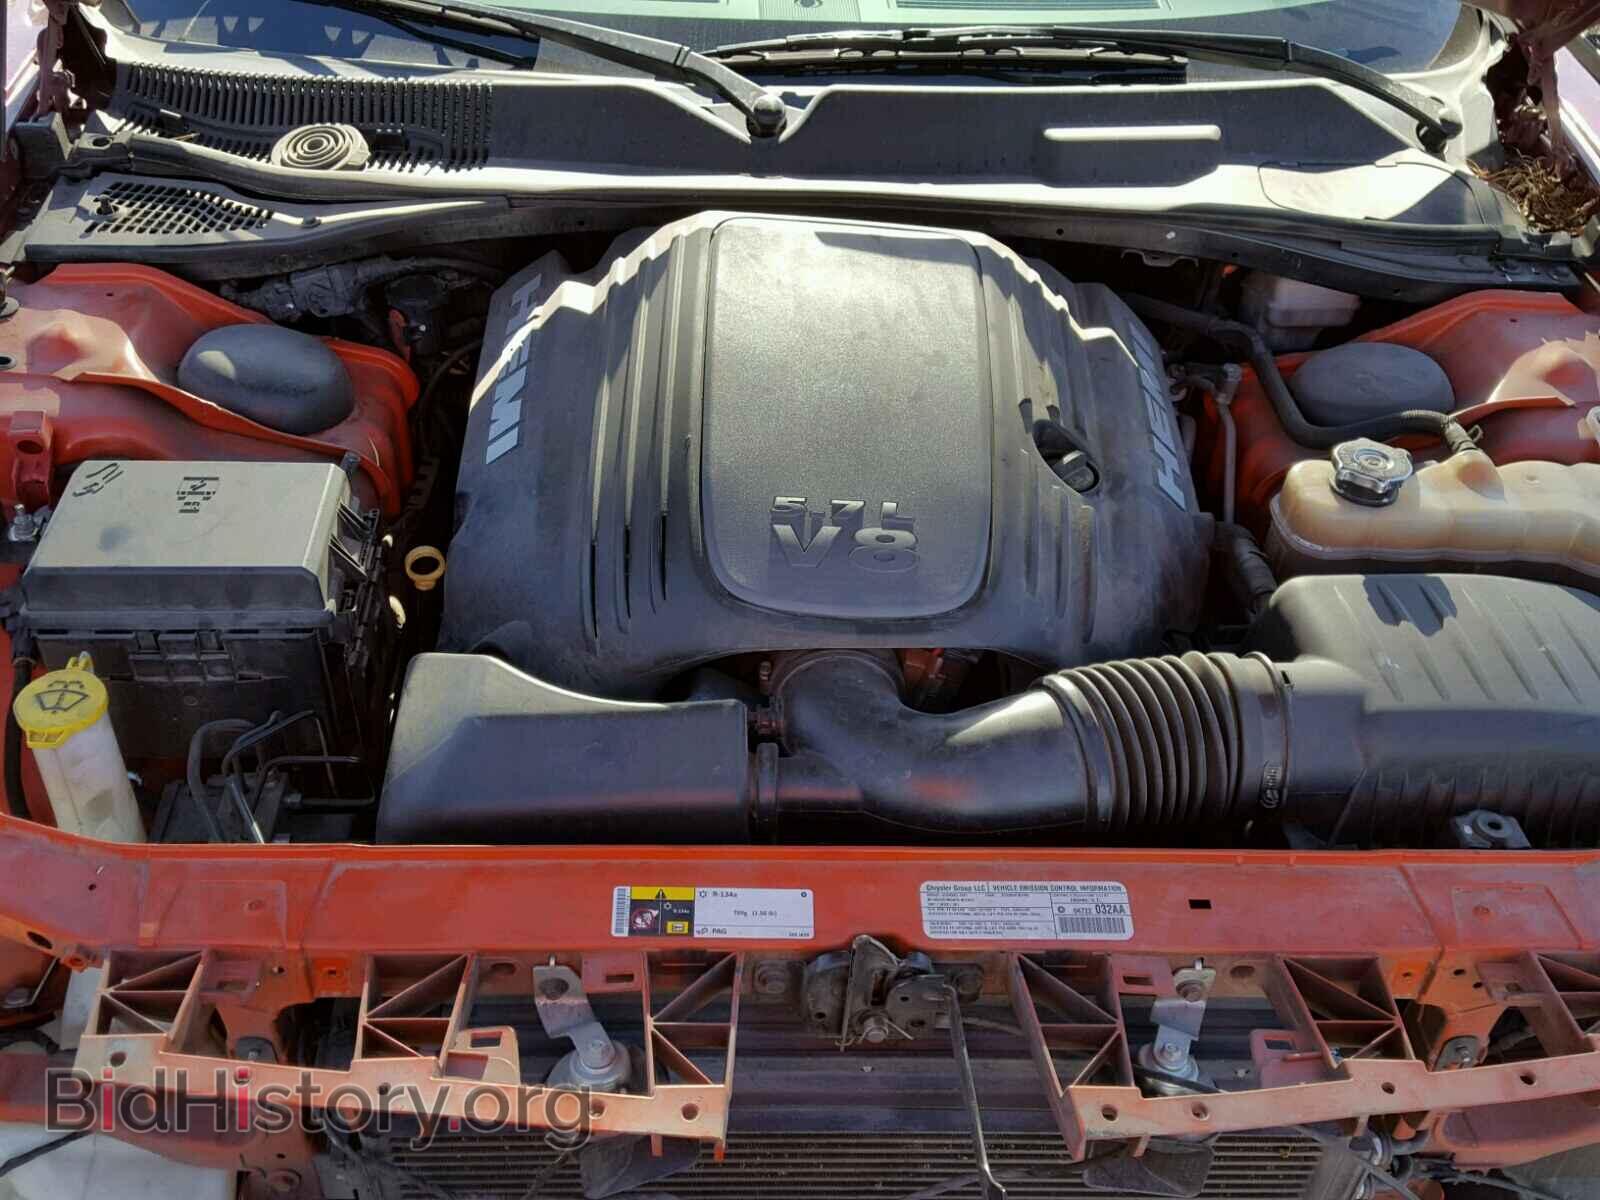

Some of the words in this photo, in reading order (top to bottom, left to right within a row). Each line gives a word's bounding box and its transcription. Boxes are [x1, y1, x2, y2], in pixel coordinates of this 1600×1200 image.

[486, 273, 542, 465] HEMI
[1128, 321, 1187, 512] HEMI
[771, 496, 915, 530] 5.7L
[772, 524, 920, 573] V8
[926, 884, 952, 893] Chrysler
[953, 884, 972, 892] Group
[974, 884, 985, 892] LLC
[992, 884, 1017, 892] VEHICLE
[1095, 904, 1125, 914] 032AA
